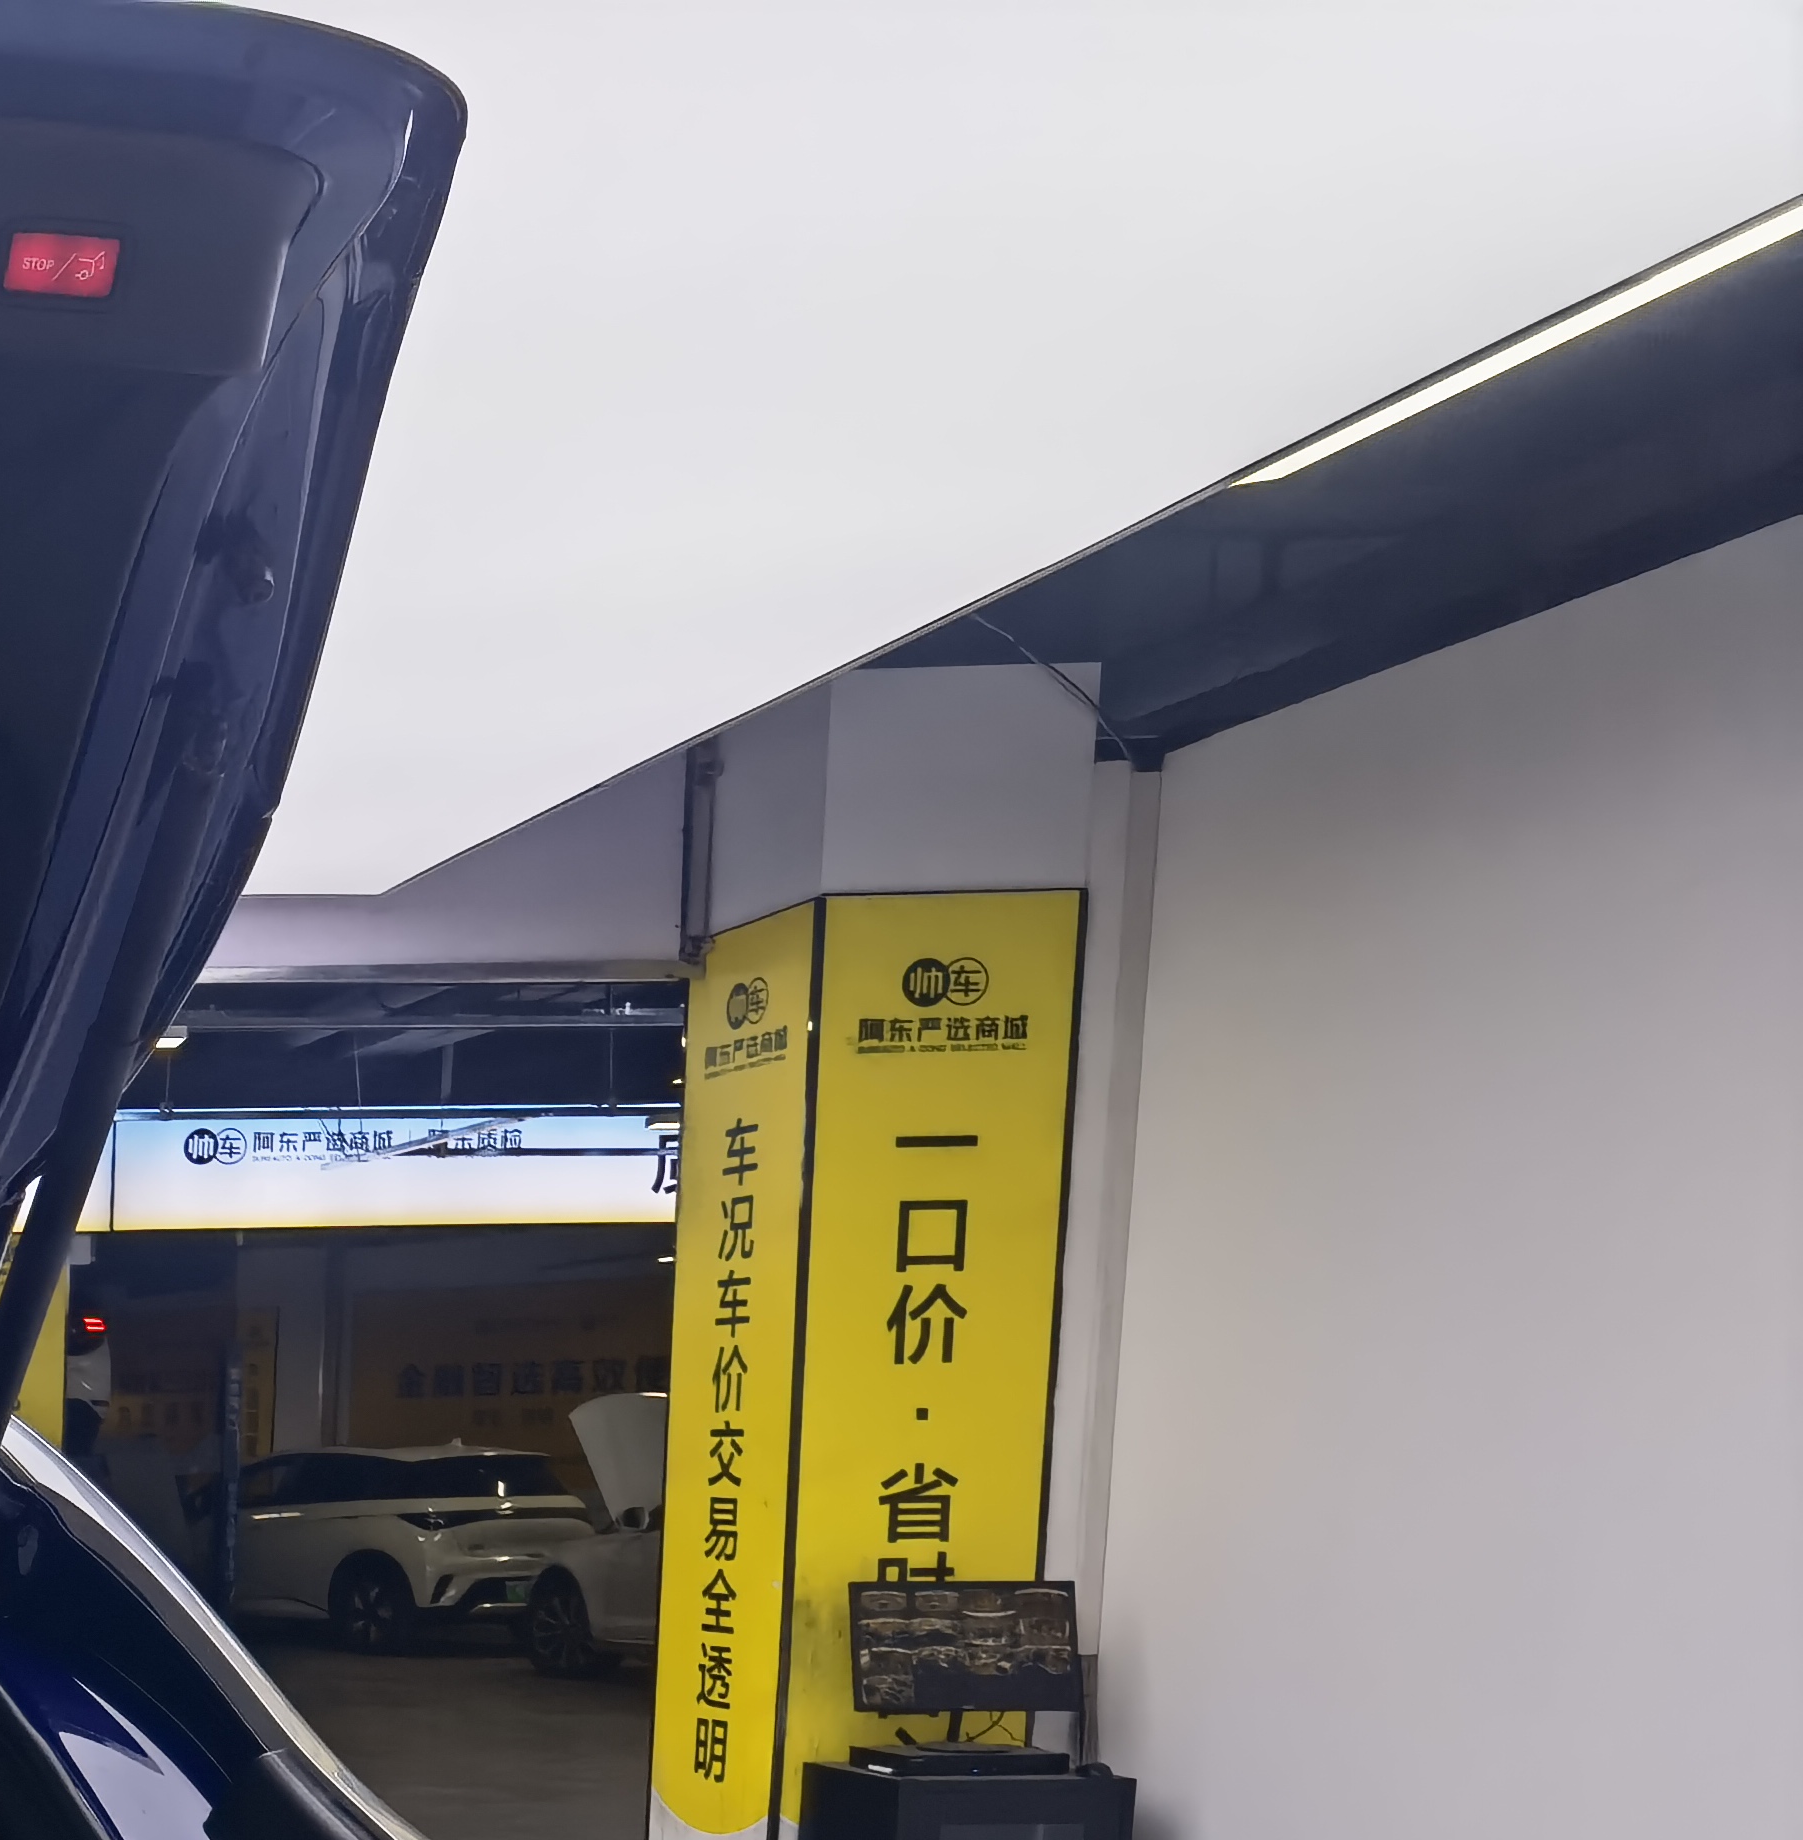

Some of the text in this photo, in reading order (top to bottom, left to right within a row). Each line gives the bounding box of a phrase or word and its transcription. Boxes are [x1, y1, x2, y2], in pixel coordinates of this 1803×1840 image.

[22, 257, 55, 271] STOP
[905, 961, 986, 1003] 帅车
[186, 1131, 244, 1162] 帅车
[693, 1117, 760, 1784] 车况车价交易全透明
